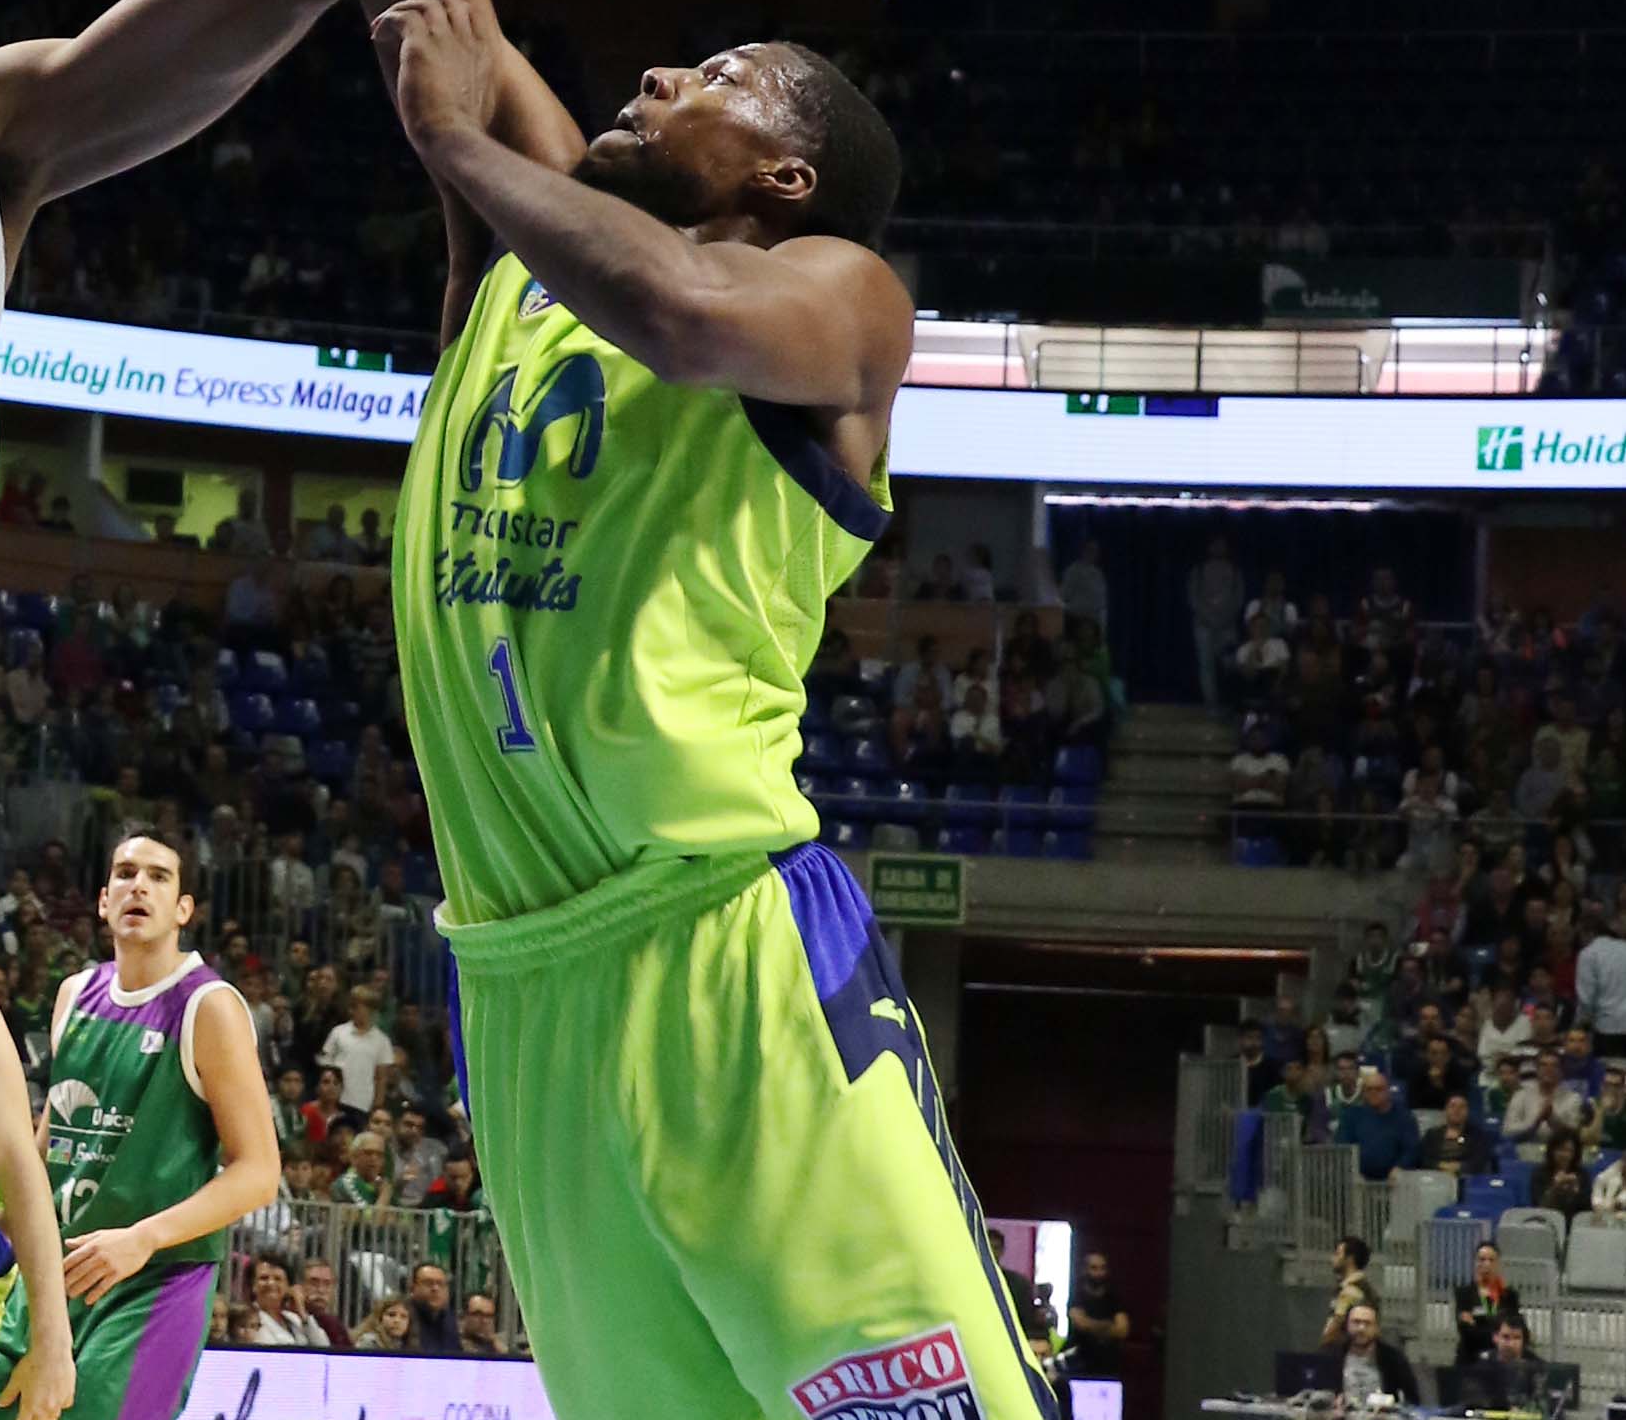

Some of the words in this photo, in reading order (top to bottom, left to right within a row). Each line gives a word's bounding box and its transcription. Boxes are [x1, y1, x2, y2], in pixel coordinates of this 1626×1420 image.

[115, 357, 166, 394] Inn
[174, 367, 282, 407] Express
[290, 378, 393, 422] Málaga
[488, 636, 535, 752] 1
[802, 1341, 956, 1408] BRICO
